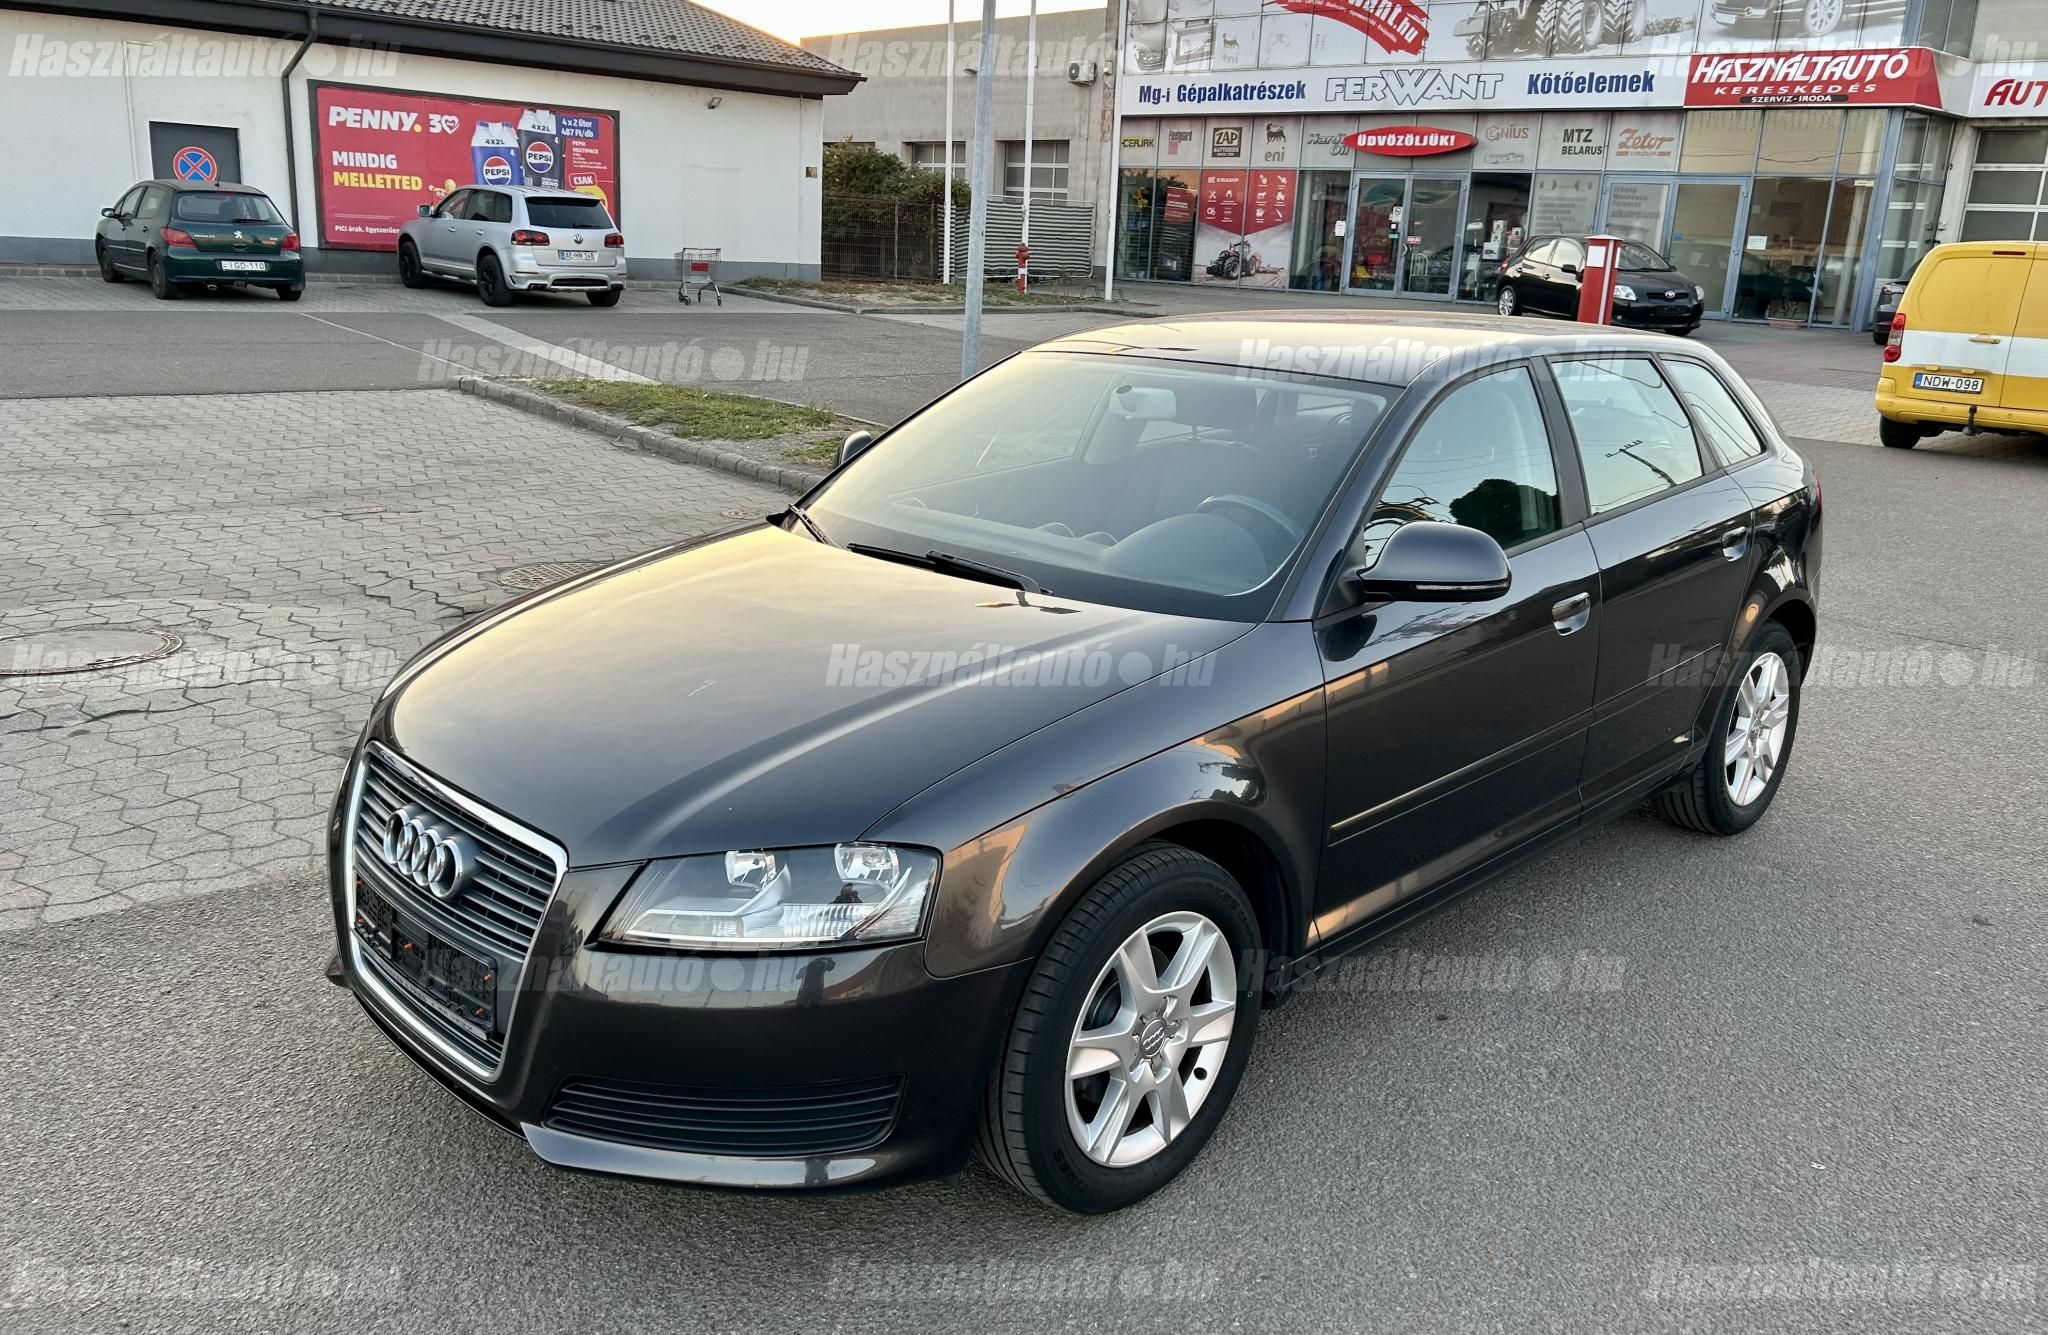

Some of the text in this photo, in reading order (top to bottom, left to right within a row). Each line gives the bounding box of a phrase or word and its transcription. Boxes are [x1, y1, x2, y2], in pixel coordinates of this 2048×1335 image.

[1692, 50, 1909, 84] HASZNÁLTAUTÓ
[1325, 68, 1504, 106] FERWANT
[1527, 71, 1654, 95] Kötőelemek
[1714, 82, 1877, 96] KERESKEDÉS
[1139, 80, 1306, 105] Mg-i Gépalkatrészek
[1215, 131, 1238, 145] ZAP
[1357, 133, 1456, 147] ÜDVÖZÖLJÜK!
[1563, 128, 1593, 143] MTZ
[1619, 128, 1675, 149] Zetor
[528, 152, 553, 162] PEPSI
[1264, 147, 1285, 162] eni
[1561, 145, 1603, 156] BELARUS
[332, 151, 398, 169] MINDIG
[333, 171, 422, 190] MELLETTED
[573, 176, 593, 185] CSAK
[1922, 375, 1979, 391] NDW-098
